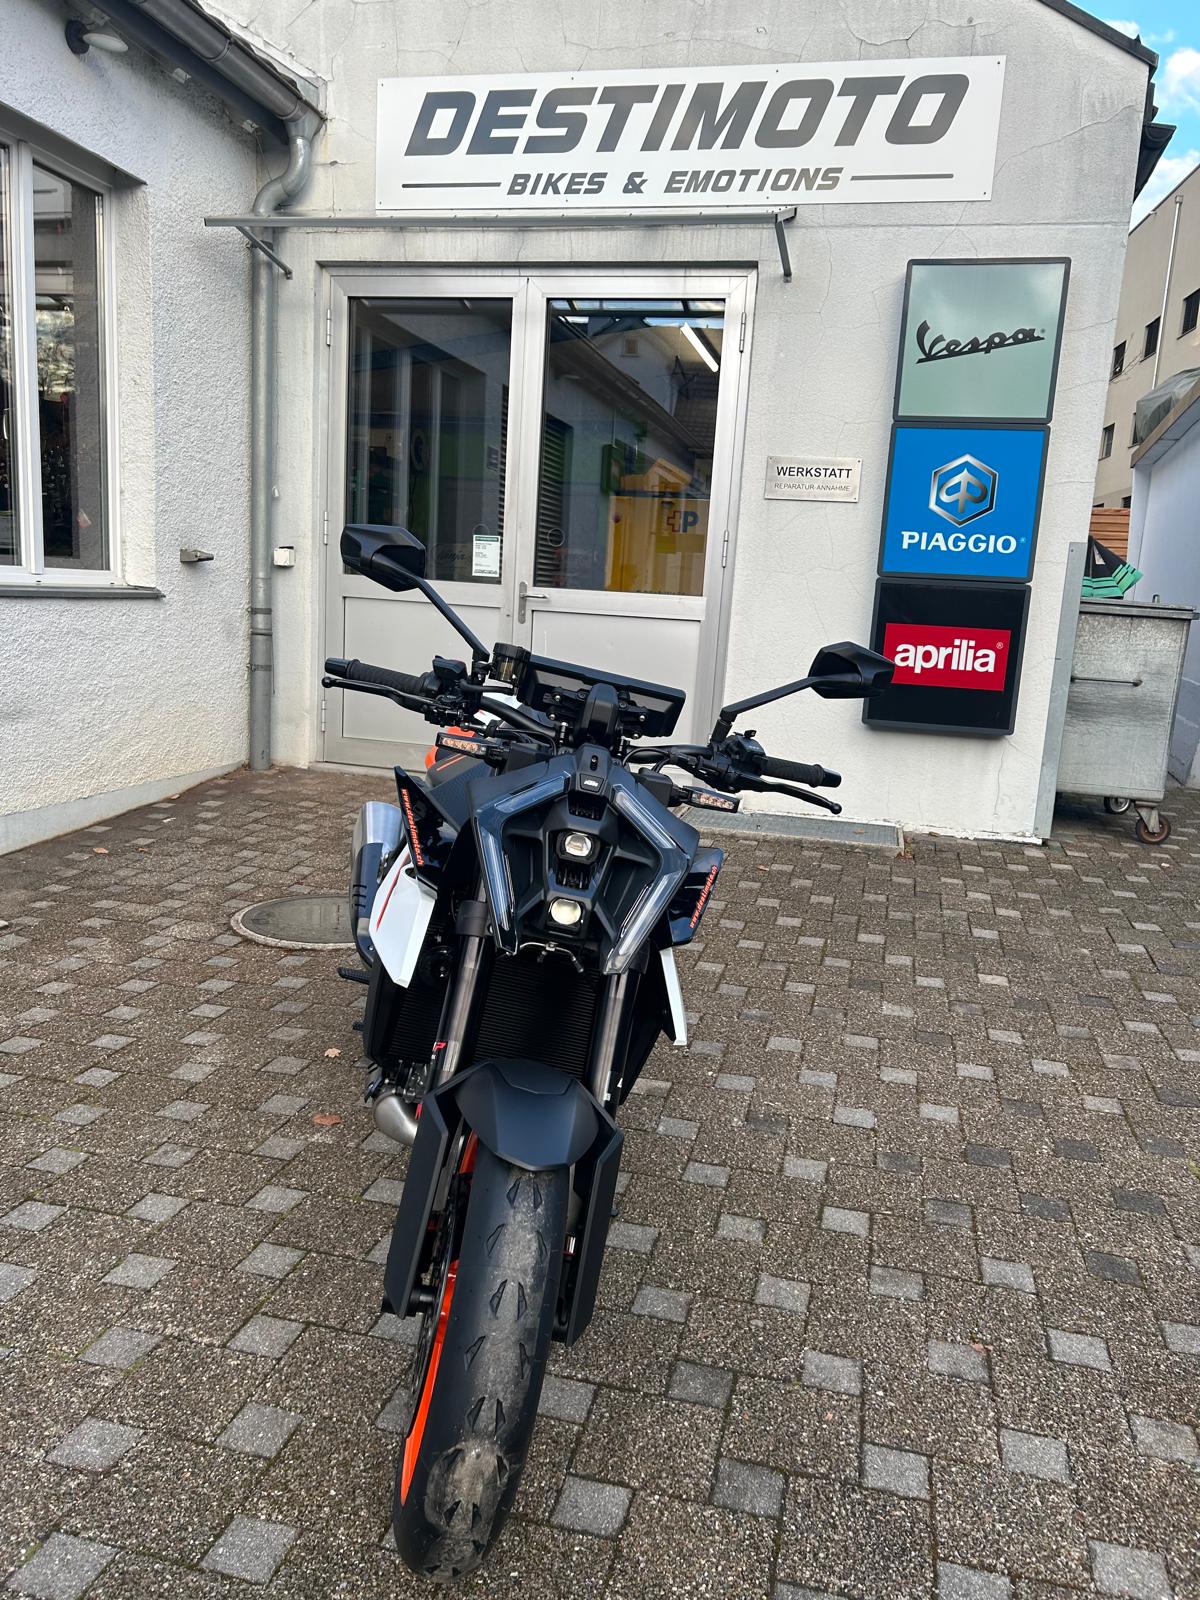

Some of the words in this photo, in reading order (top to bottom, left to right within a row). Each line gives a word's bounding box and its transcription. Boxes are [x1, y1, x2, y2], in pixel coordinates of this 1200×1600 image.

[404, 74, 970, 156] DESTIMOTO
[507, 172, 608, 196] BIKES
[623, 171, 647, 194] &
[664, 167, 844, 194] EMOTIONS
[916, 320, 1045, 364] Vespa
[776, 466, 853, 479] WERKSTATT
[901, 531, 1017, 554] PIAGGIO
[894, 638, 996, 674] aprilia
[401, 788, 424, 865] www.destimoto.ch
[689, 865, 718, 928] www.destimoto.ch
